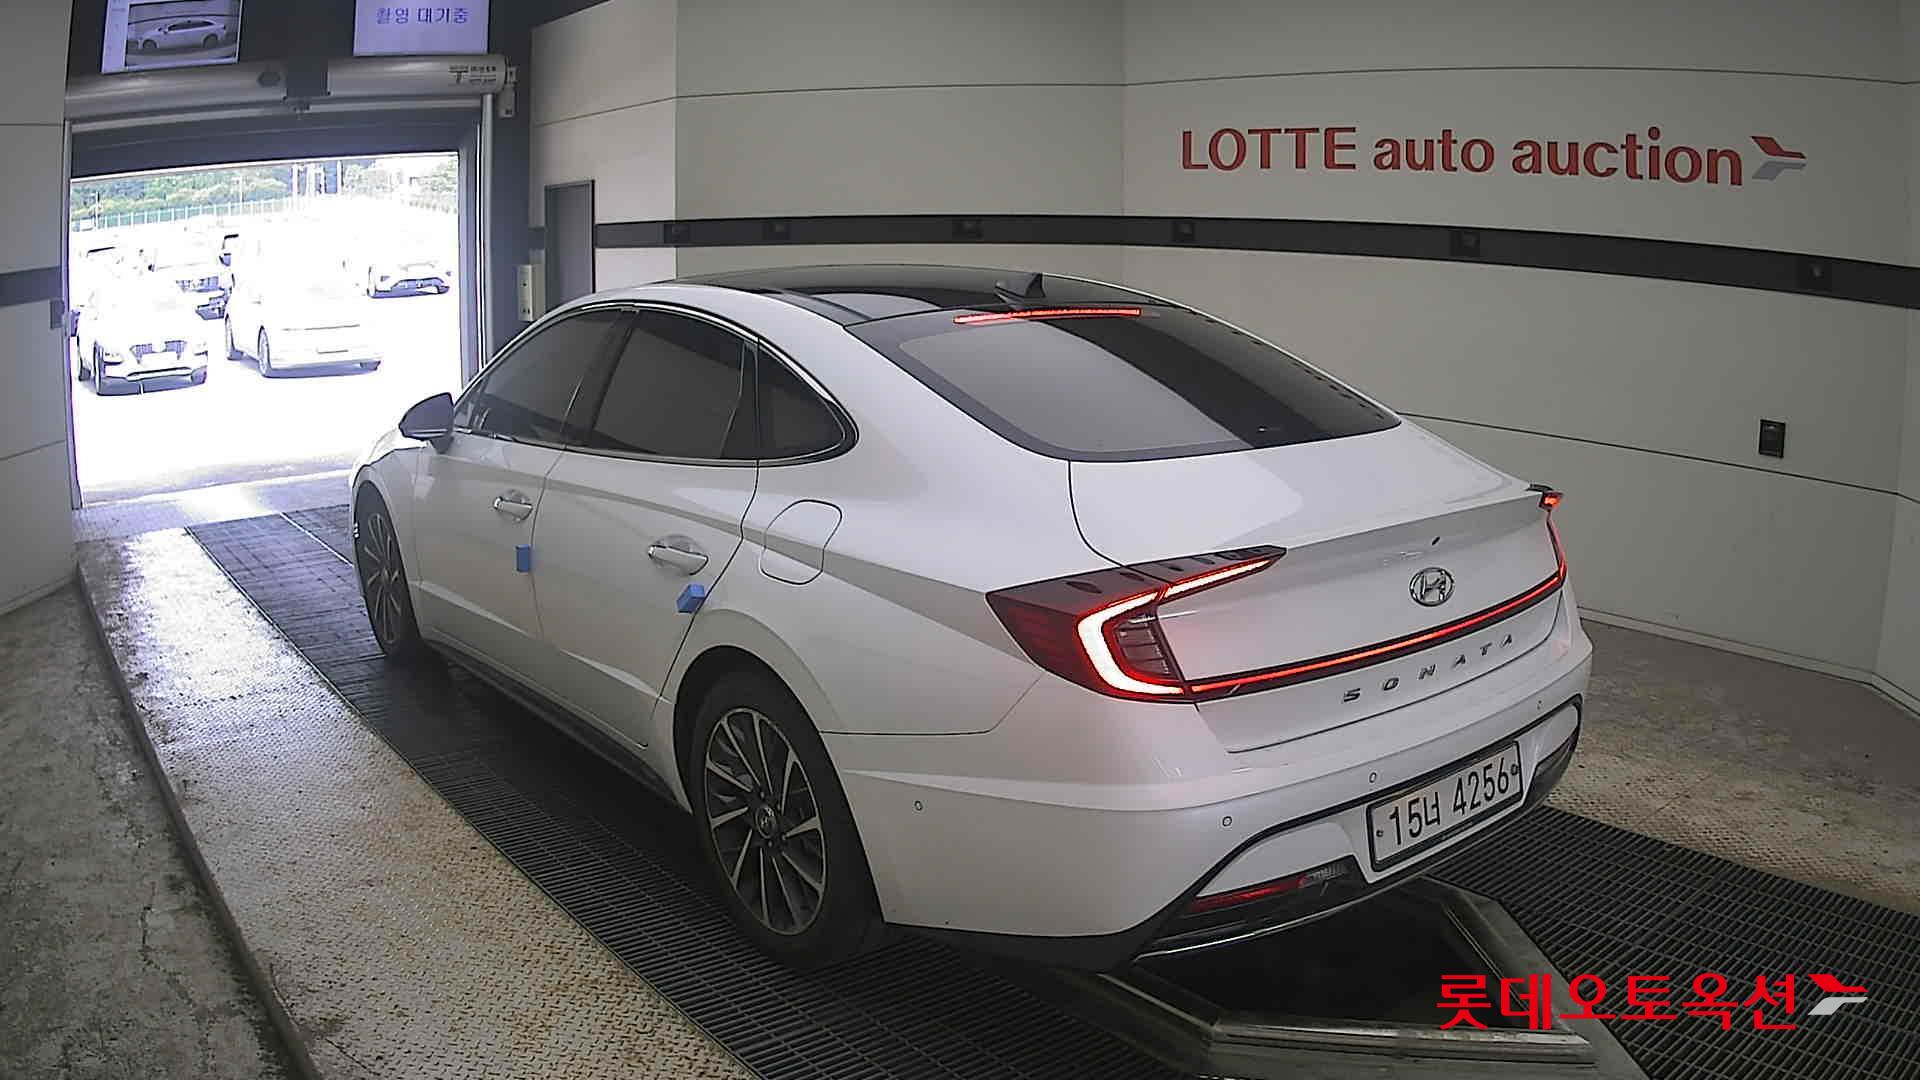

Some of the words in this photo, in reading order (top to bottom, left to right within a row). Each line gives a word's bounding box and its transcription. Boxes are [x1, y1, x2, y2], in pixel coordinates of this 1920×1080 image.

[418, 7, 469, 24] 대기중
[1182, 127, 1357, 171] LOTTE
[1374, 129, 1495, 173] auto
[1512, 126, 1743, 186] auction
[1343, 634, 1513, 703] SONATA
[1389, 791, 1441, 846] 15너
[1453, 757, 1509, 816] 4256
